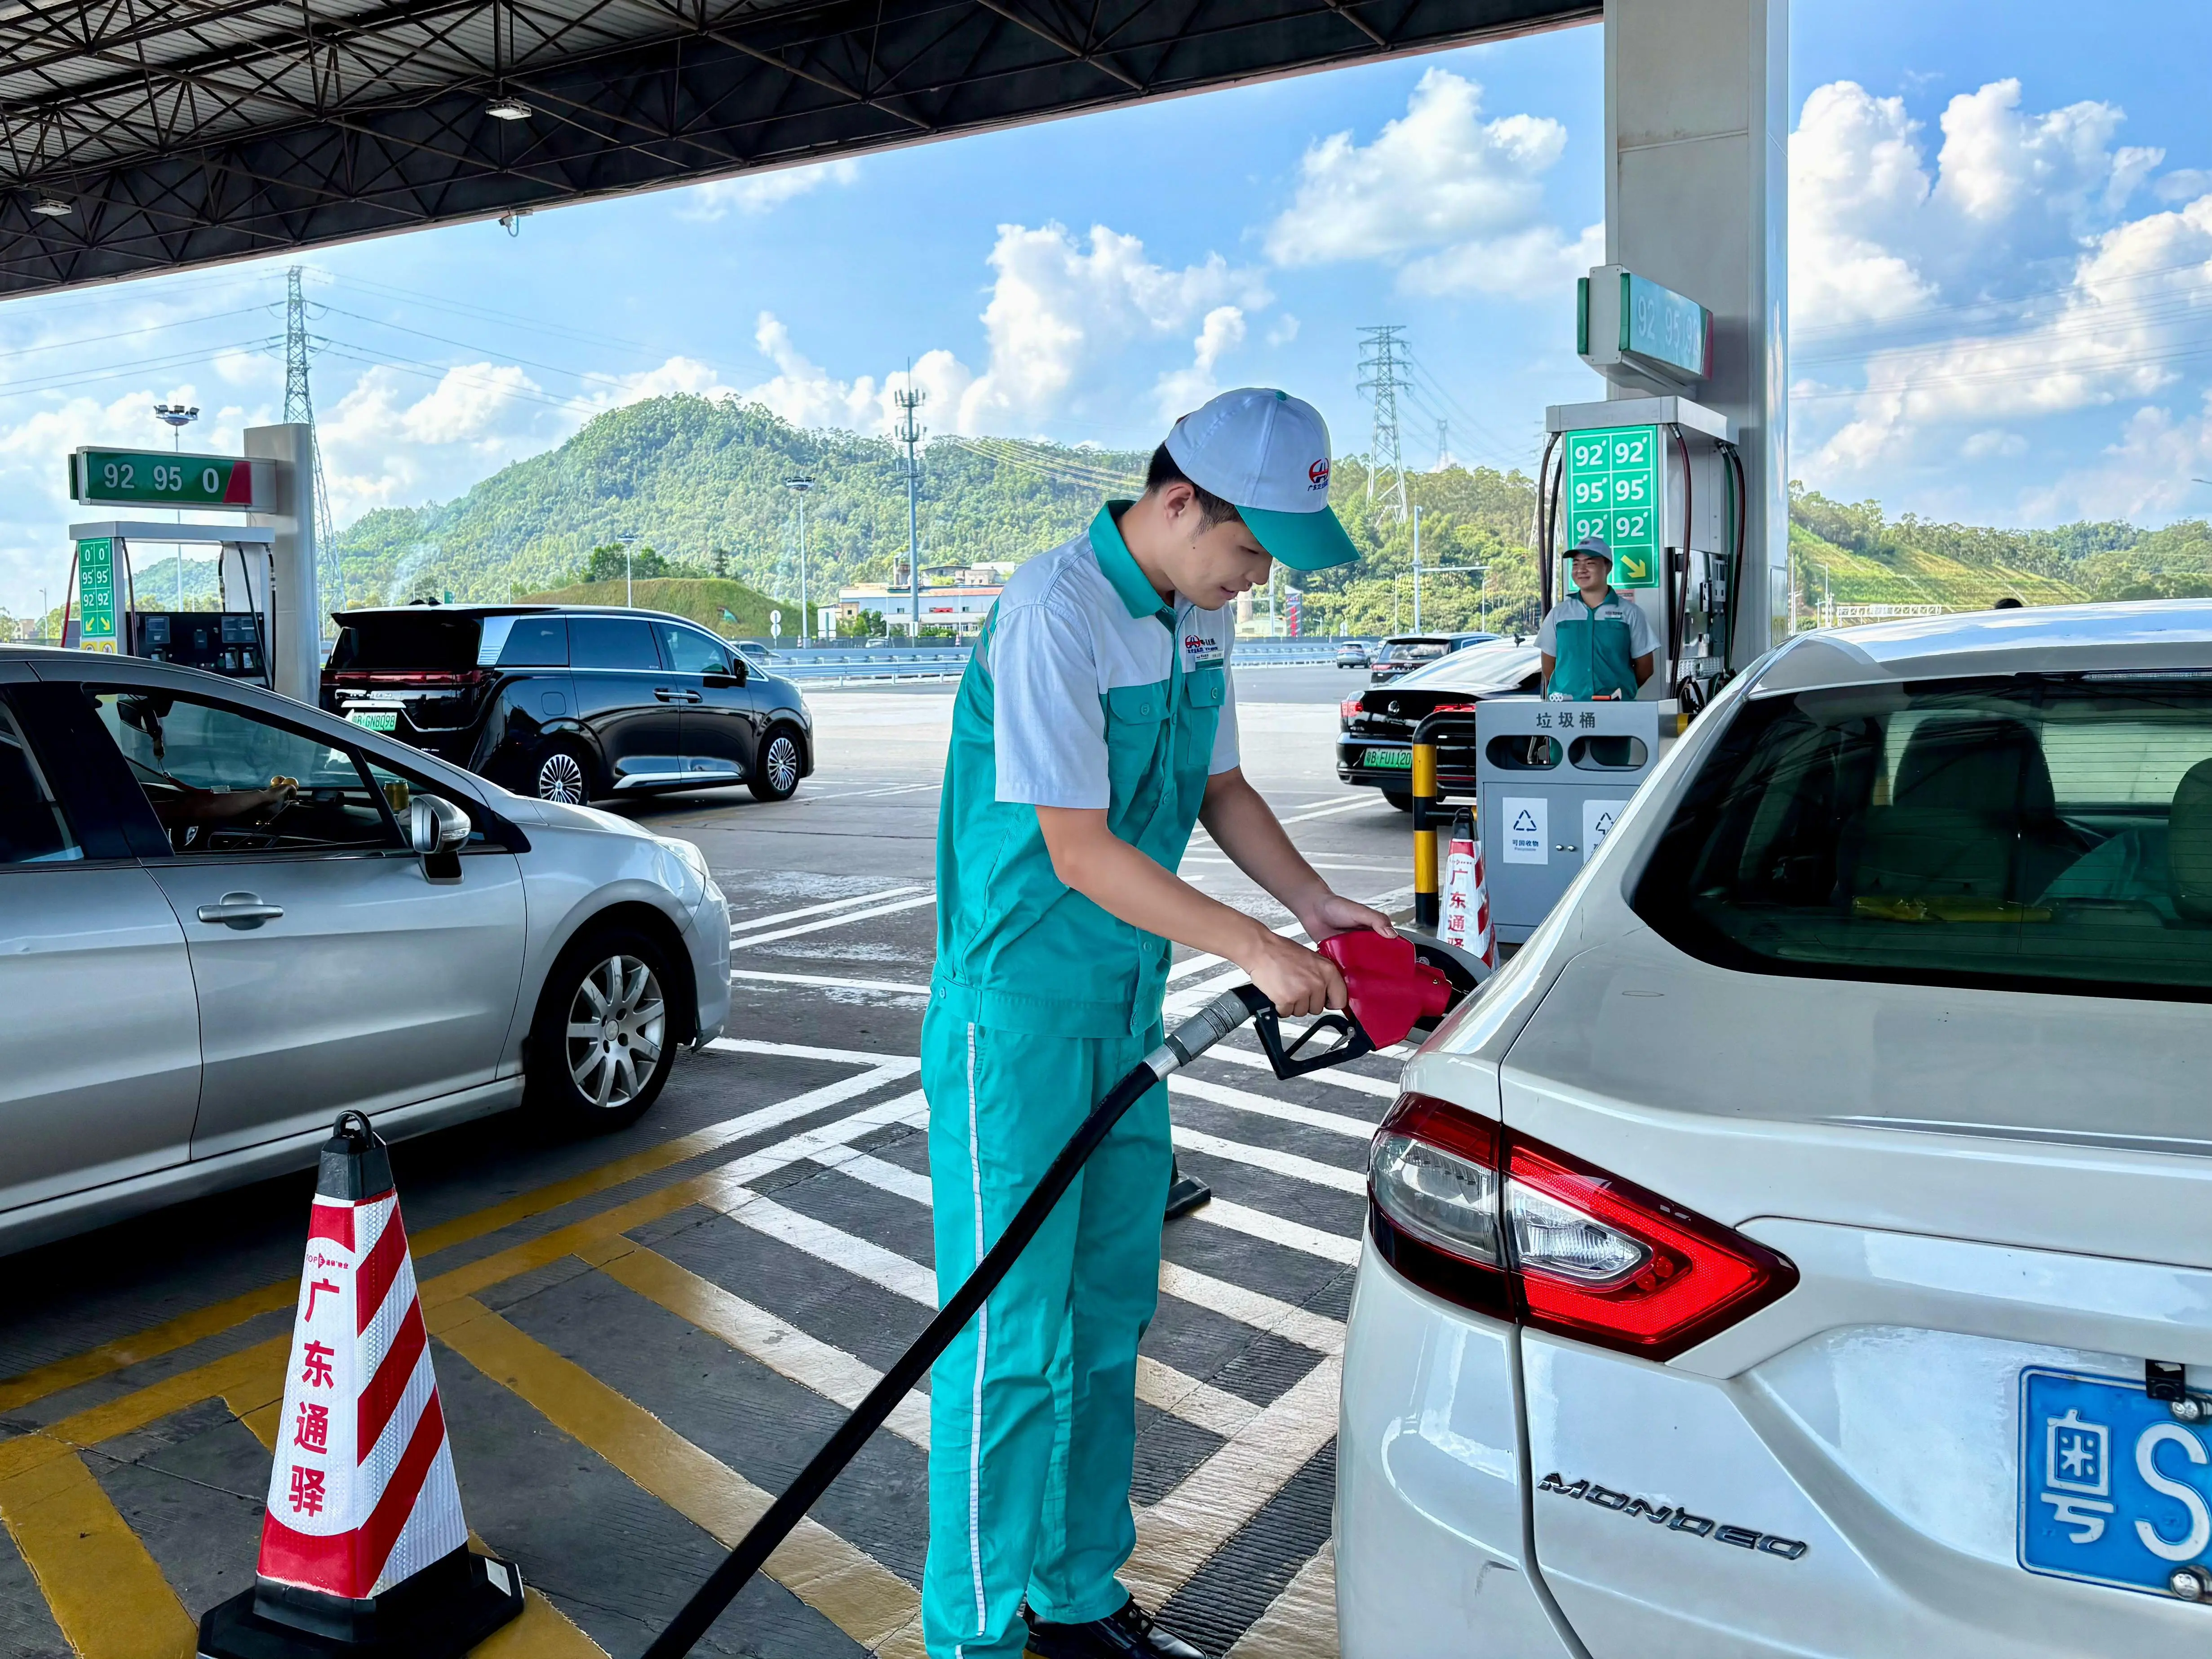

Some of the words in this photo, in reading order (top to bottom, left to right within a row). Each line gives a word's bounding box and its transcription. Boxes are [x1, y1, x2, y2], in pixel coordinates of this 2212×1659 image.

[1638, 295, 1655, 340] 92
[1665, 306, 1680, 349] 95
[104, 463, 135, 489] 92
[153, 466, 182, 492] 95
[203, 467, 219, 493] 0
[1536, 711, 1596, 728] 垃圾桶
[288, 1278, 341, 1517] 广东通驿
[1537, 1471, 1809, 1561] MONDEO
